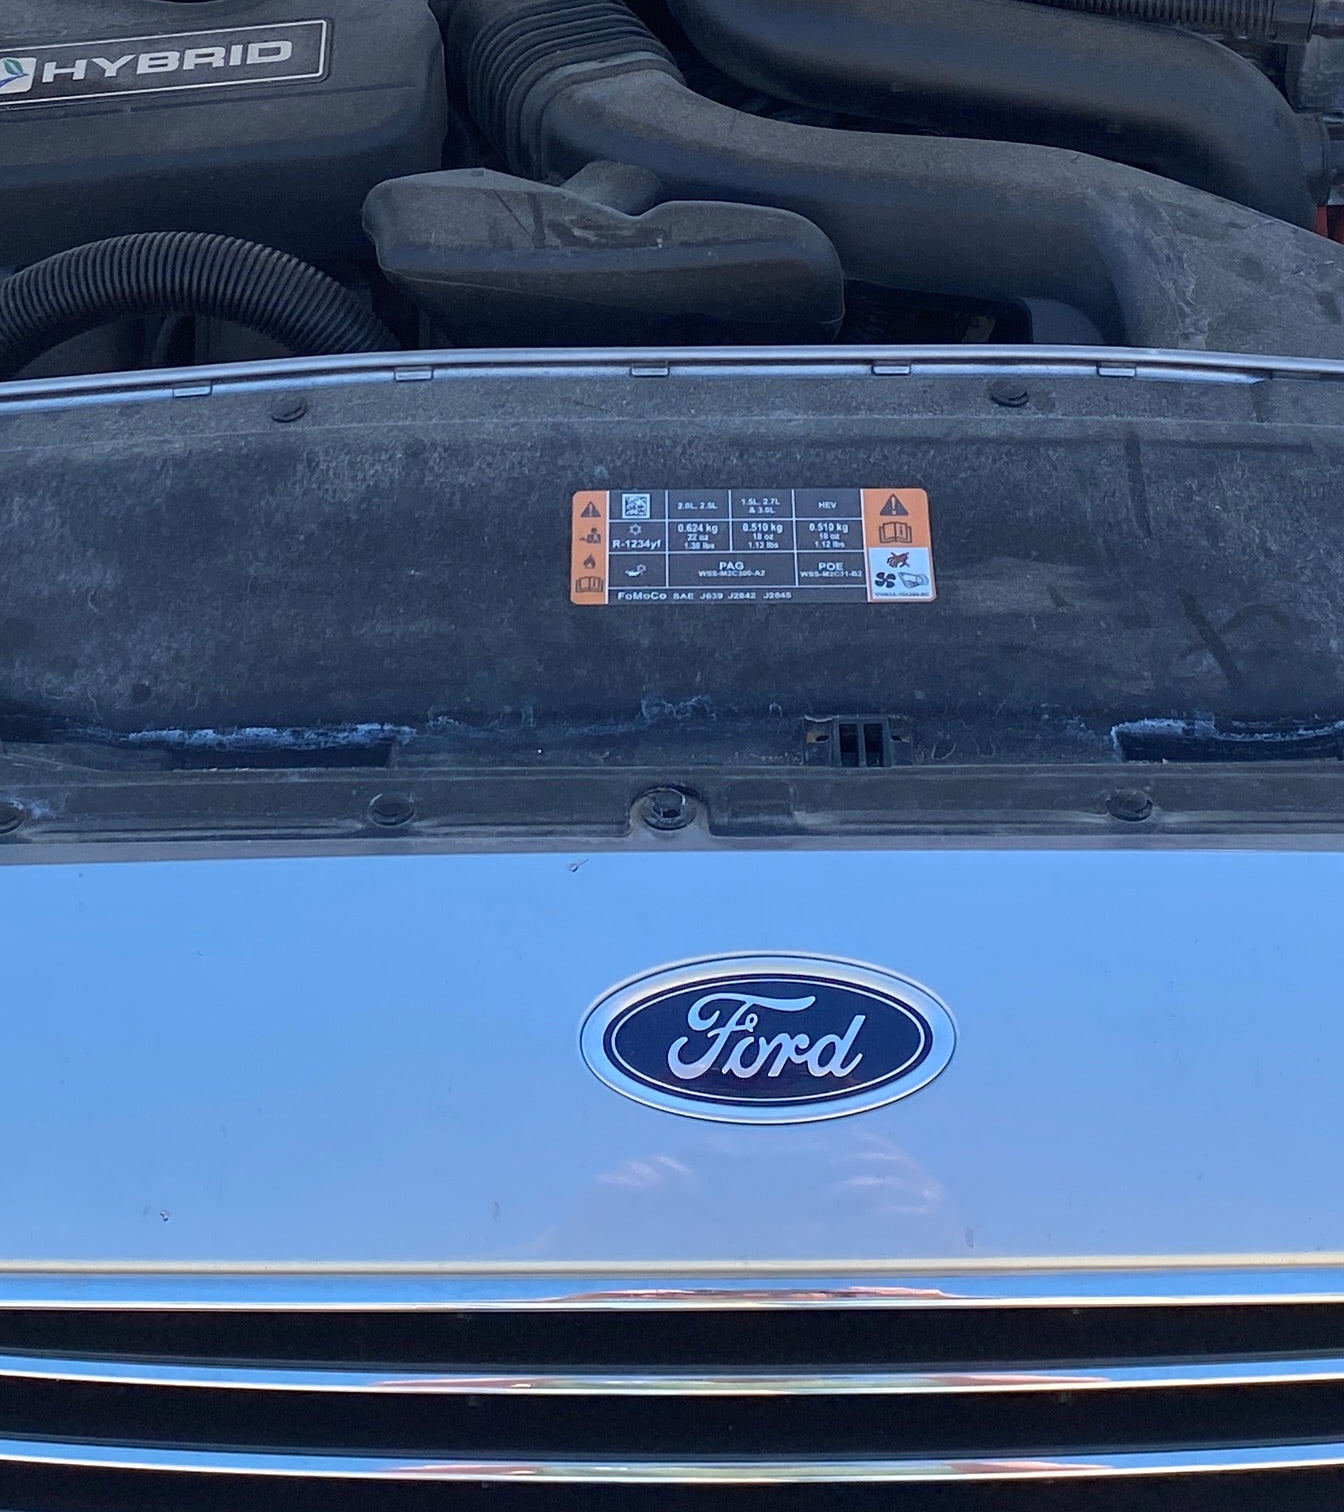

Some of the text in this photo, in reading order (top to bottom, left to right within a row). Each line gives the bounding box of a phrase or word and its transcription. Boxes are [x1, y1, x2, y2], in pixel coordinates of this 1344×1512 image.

[42, 40, 292, 83] HYBRID
[699, 501, 718, 510] 2.5L
[762, 497, 781, 506] 2.7L
[817, 501, 837, 510] HEV
[677, 523, 719, 535] 0.624 kg
[742, 522, 784, 534] 0.510 kg
[808, 522, 849, 534] 0.510 kg
[819, 532, 829, 540] 18
[612, 539, 662, 551] R-1234yf
[702, 542, 716, 550] lbs
[748, 541, 780, 549] 1.12 lbs
[814, 541, 846, 549] 1.12 lbs
[718, 561, 745, 571] PAG
[818, 562, 844, 571] POE
[617, 591, 667, 601] FoMoCo
[672, 592, 695, 601] SAE
[699, 592, 724, 601] J639
[727, 591, 757, 600] J2842
[667, 992, 866, 1079] Ford
